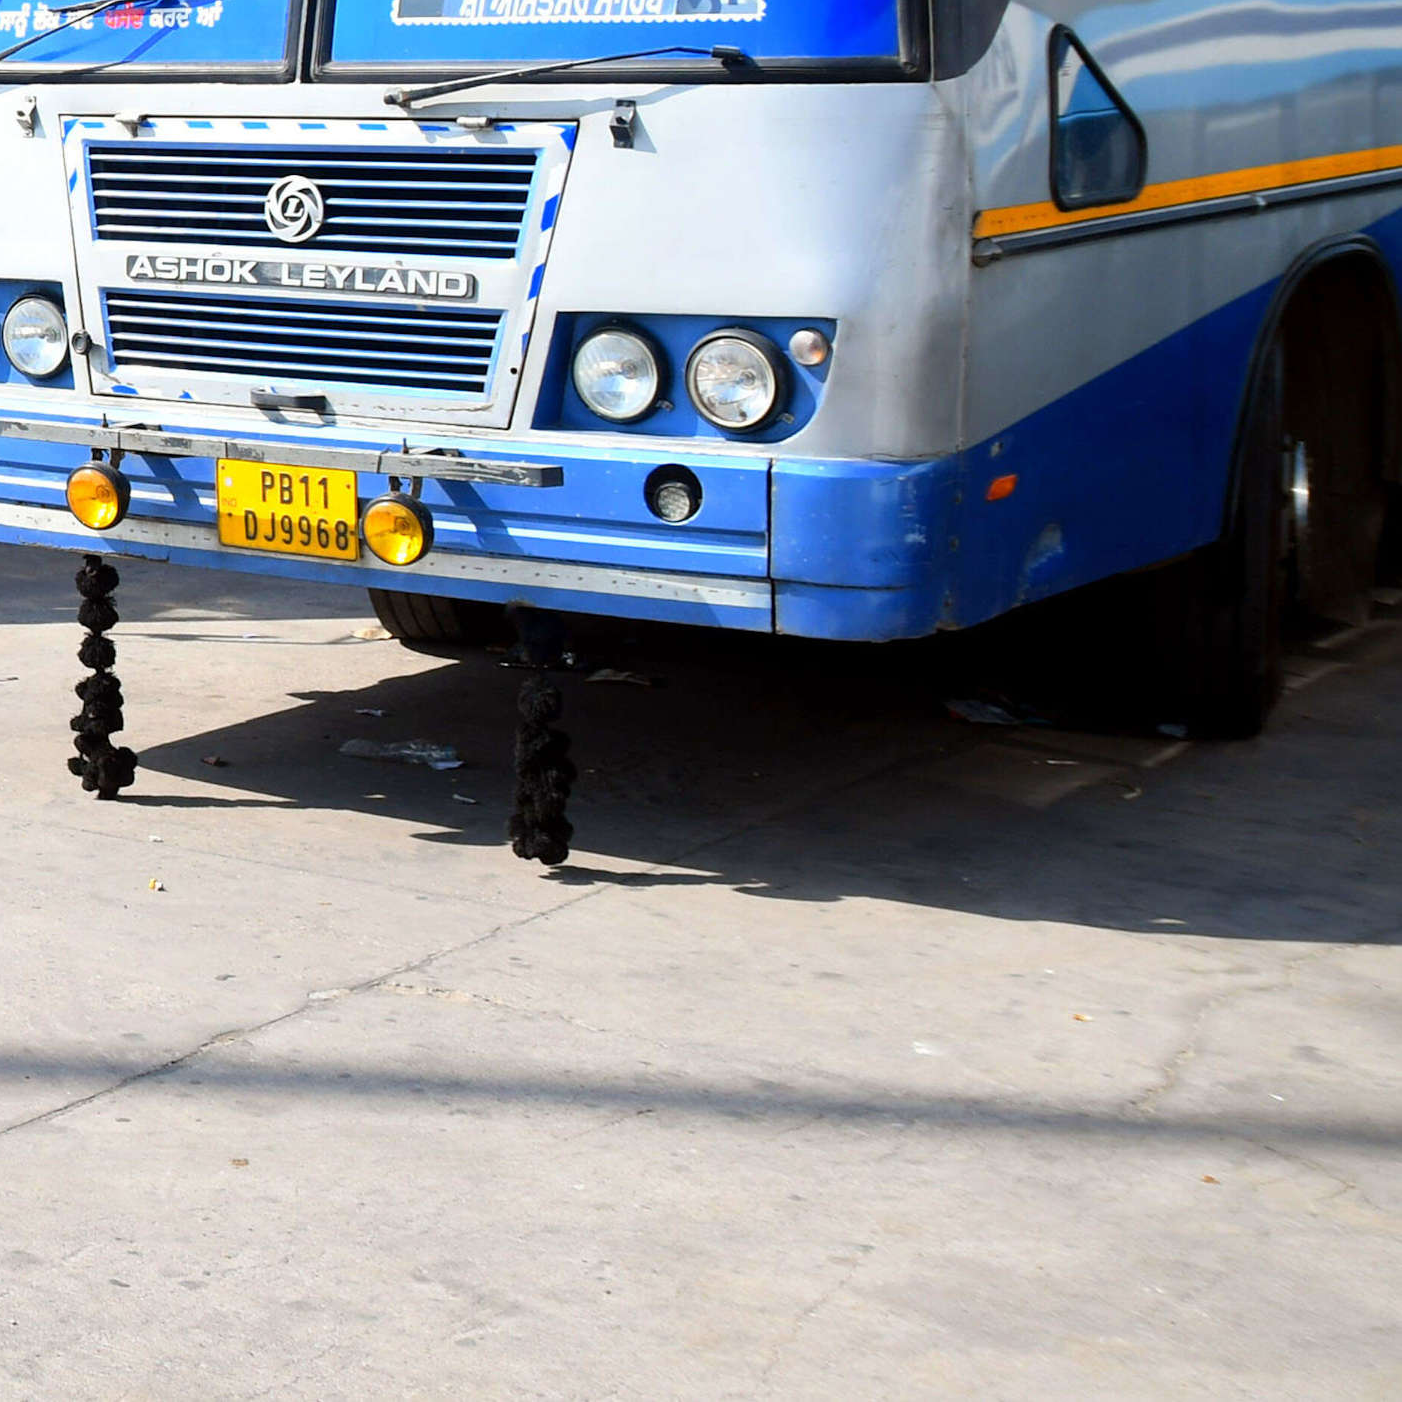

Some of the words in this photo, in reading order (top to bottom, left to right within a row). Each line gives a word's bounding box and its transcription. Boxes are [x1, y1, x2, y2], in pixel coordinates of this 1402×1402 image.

[129, 255, 260, 284] ASHOK
[280, 262, 471, 297] LEYLAND
[260, 471, 329, 509] PB11
[244, 509, 350, 551] DJ9968
